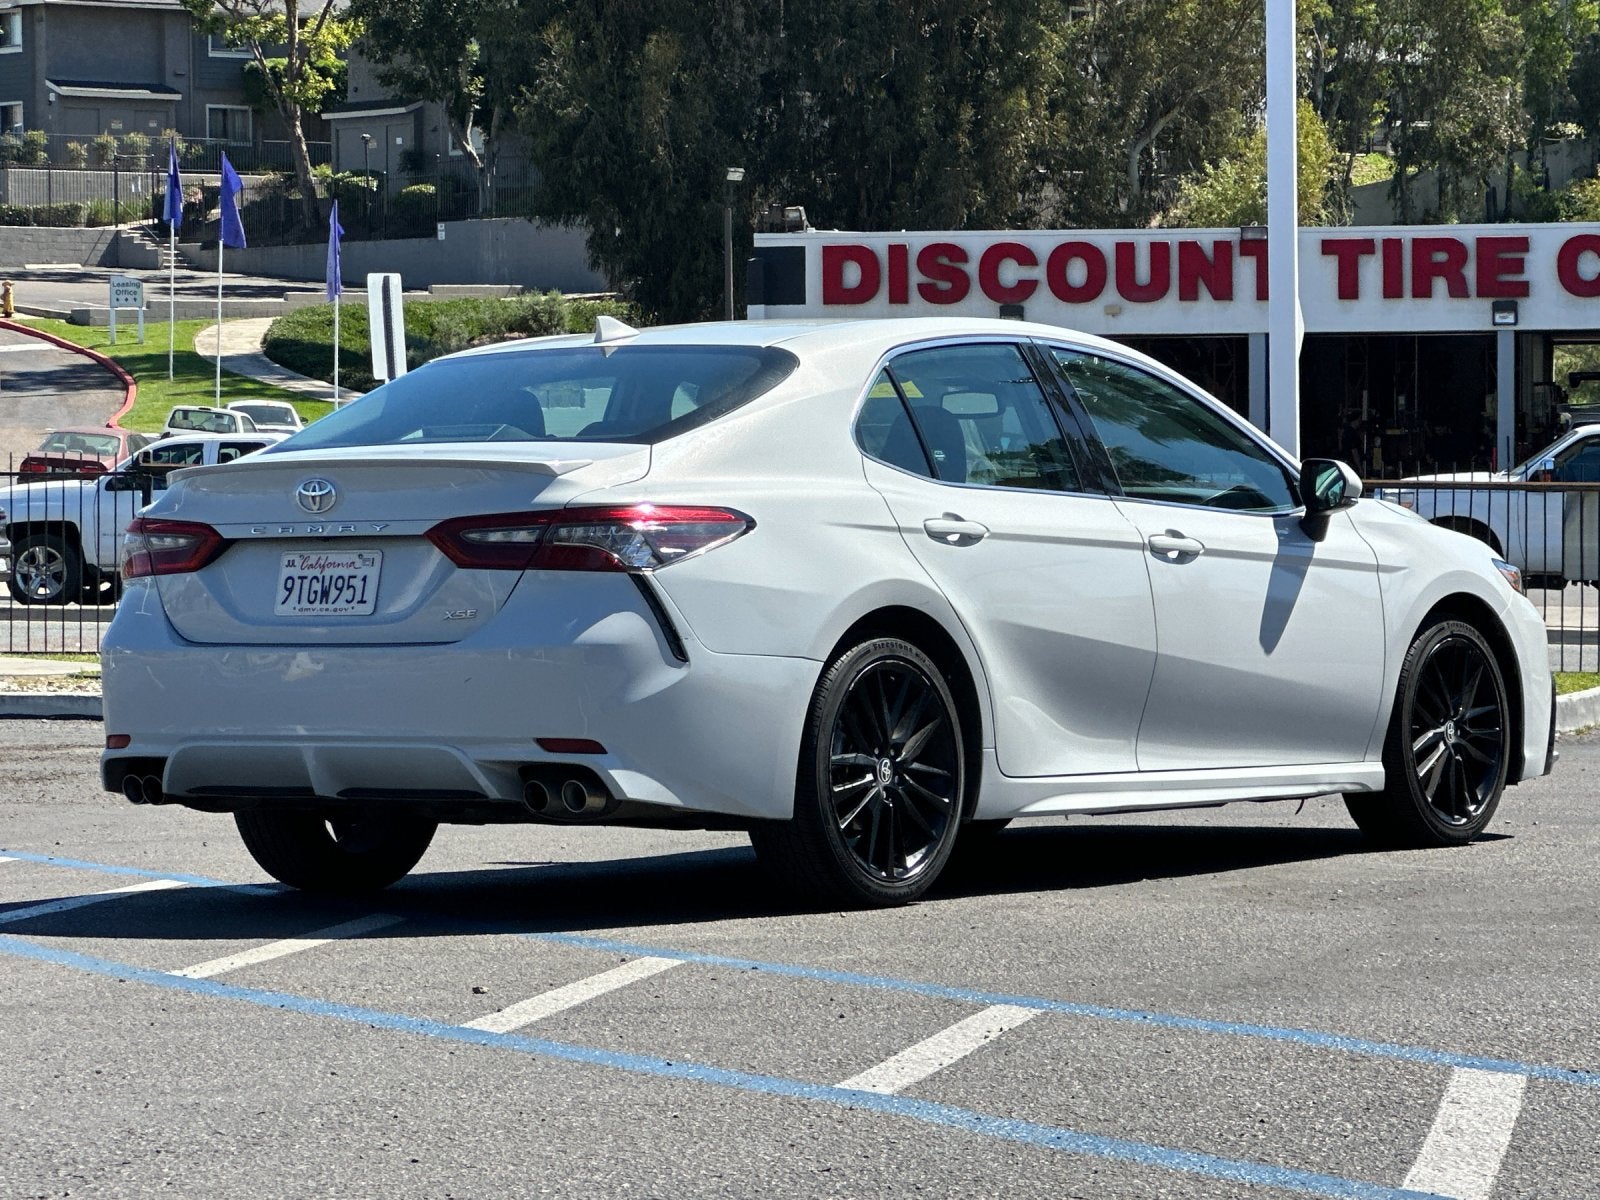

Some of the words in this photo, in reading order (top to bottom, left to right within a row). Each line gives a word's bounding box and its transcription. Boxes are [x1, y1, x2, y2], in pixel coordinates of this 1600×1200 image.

[1321, 236, 1530, 300] TIRE
[112, 281, 140, 289] Leasing
[251, 523, 389, 534] CAMRY
[300, 555, 361, 574] California
[281, 575, 367, 605] 9TGW951
[443, 609, 477, 620] XSE
